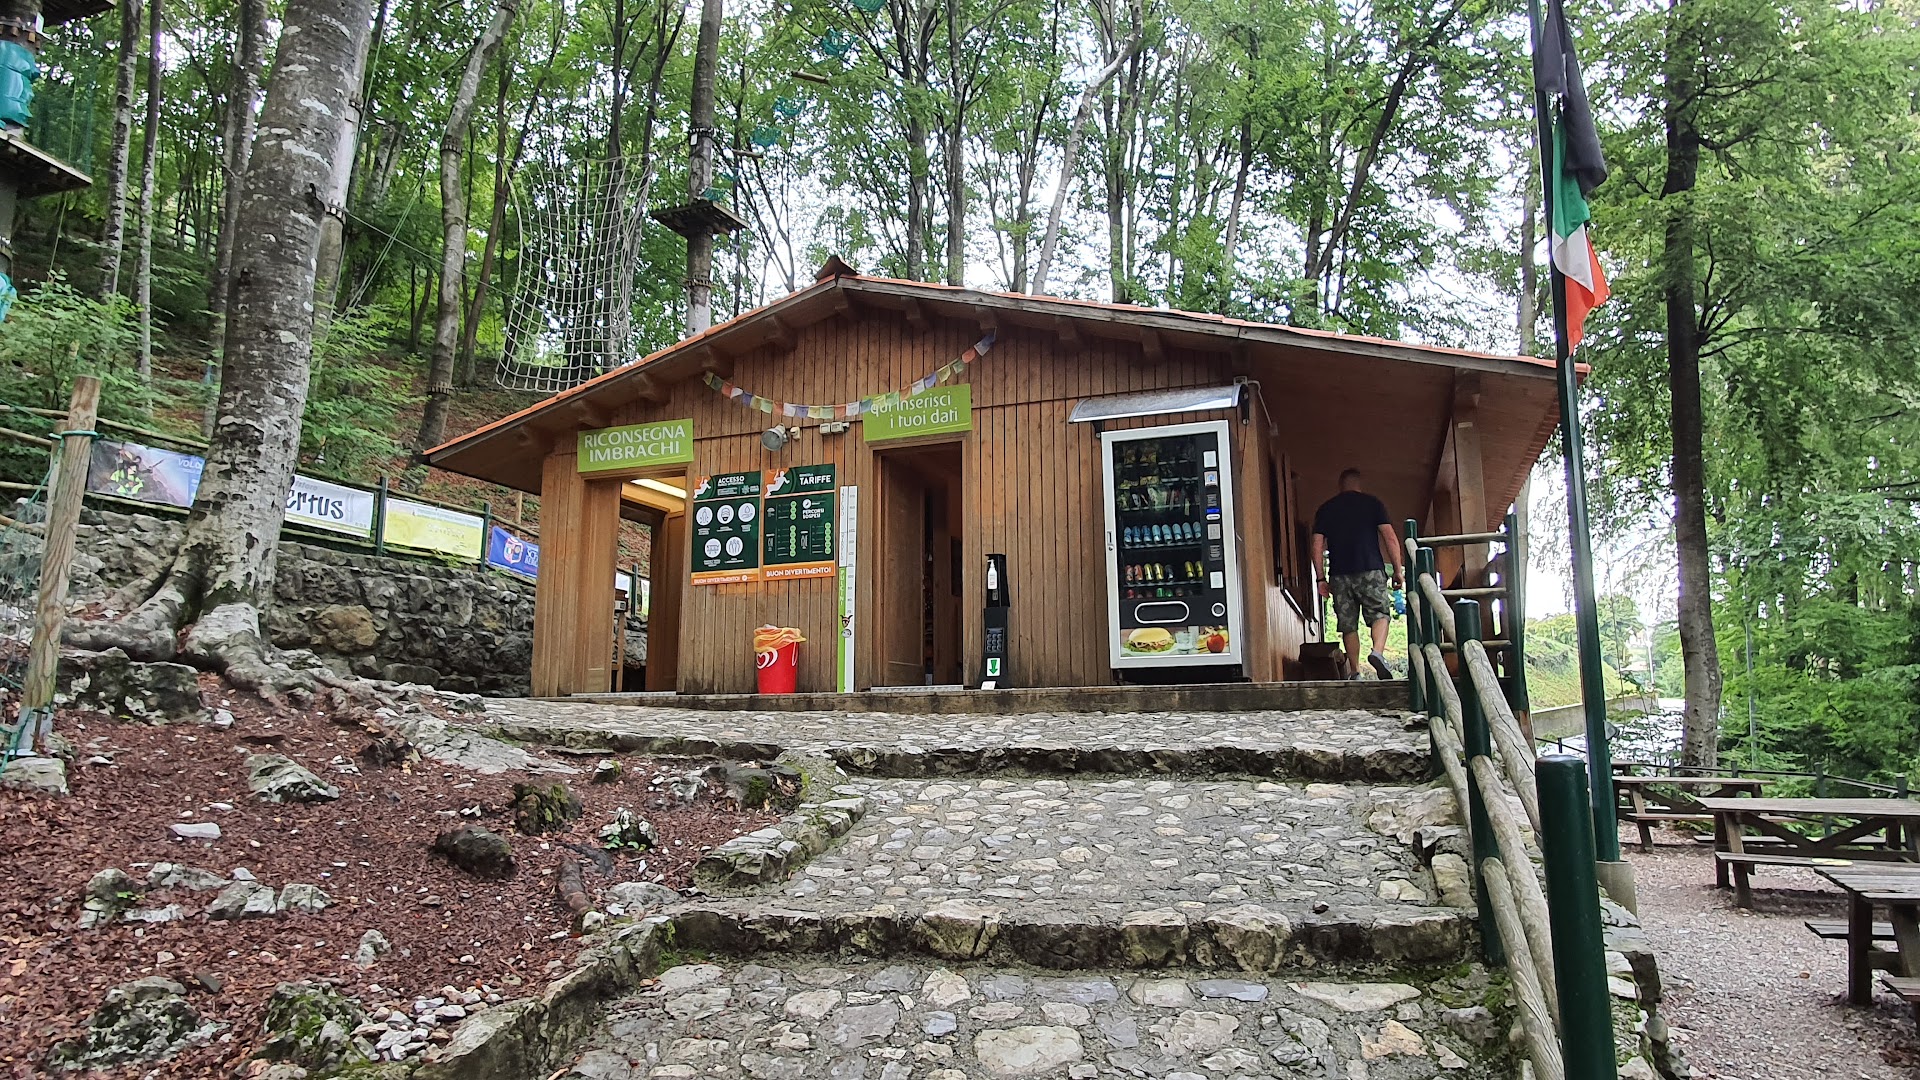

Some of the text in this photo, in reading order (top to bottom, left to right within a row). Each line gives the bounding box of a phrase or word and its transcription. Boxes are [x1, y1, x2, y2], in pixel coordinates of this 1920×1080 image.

[896, 391, 951, 411] inserisci
[898, 410, 926, 427] tuoi
[930, 406, 958, 424] dati
[584, 424, 686, 448] RICONSEGNA
[589, 440, 680, 463] IMBRACHI
[717, 475, 745, 483] ACCESSO
[799, 474, 832, 485] TARIFFE
[766, 566, 832, 578] BUON DIVERTIMENTO!
